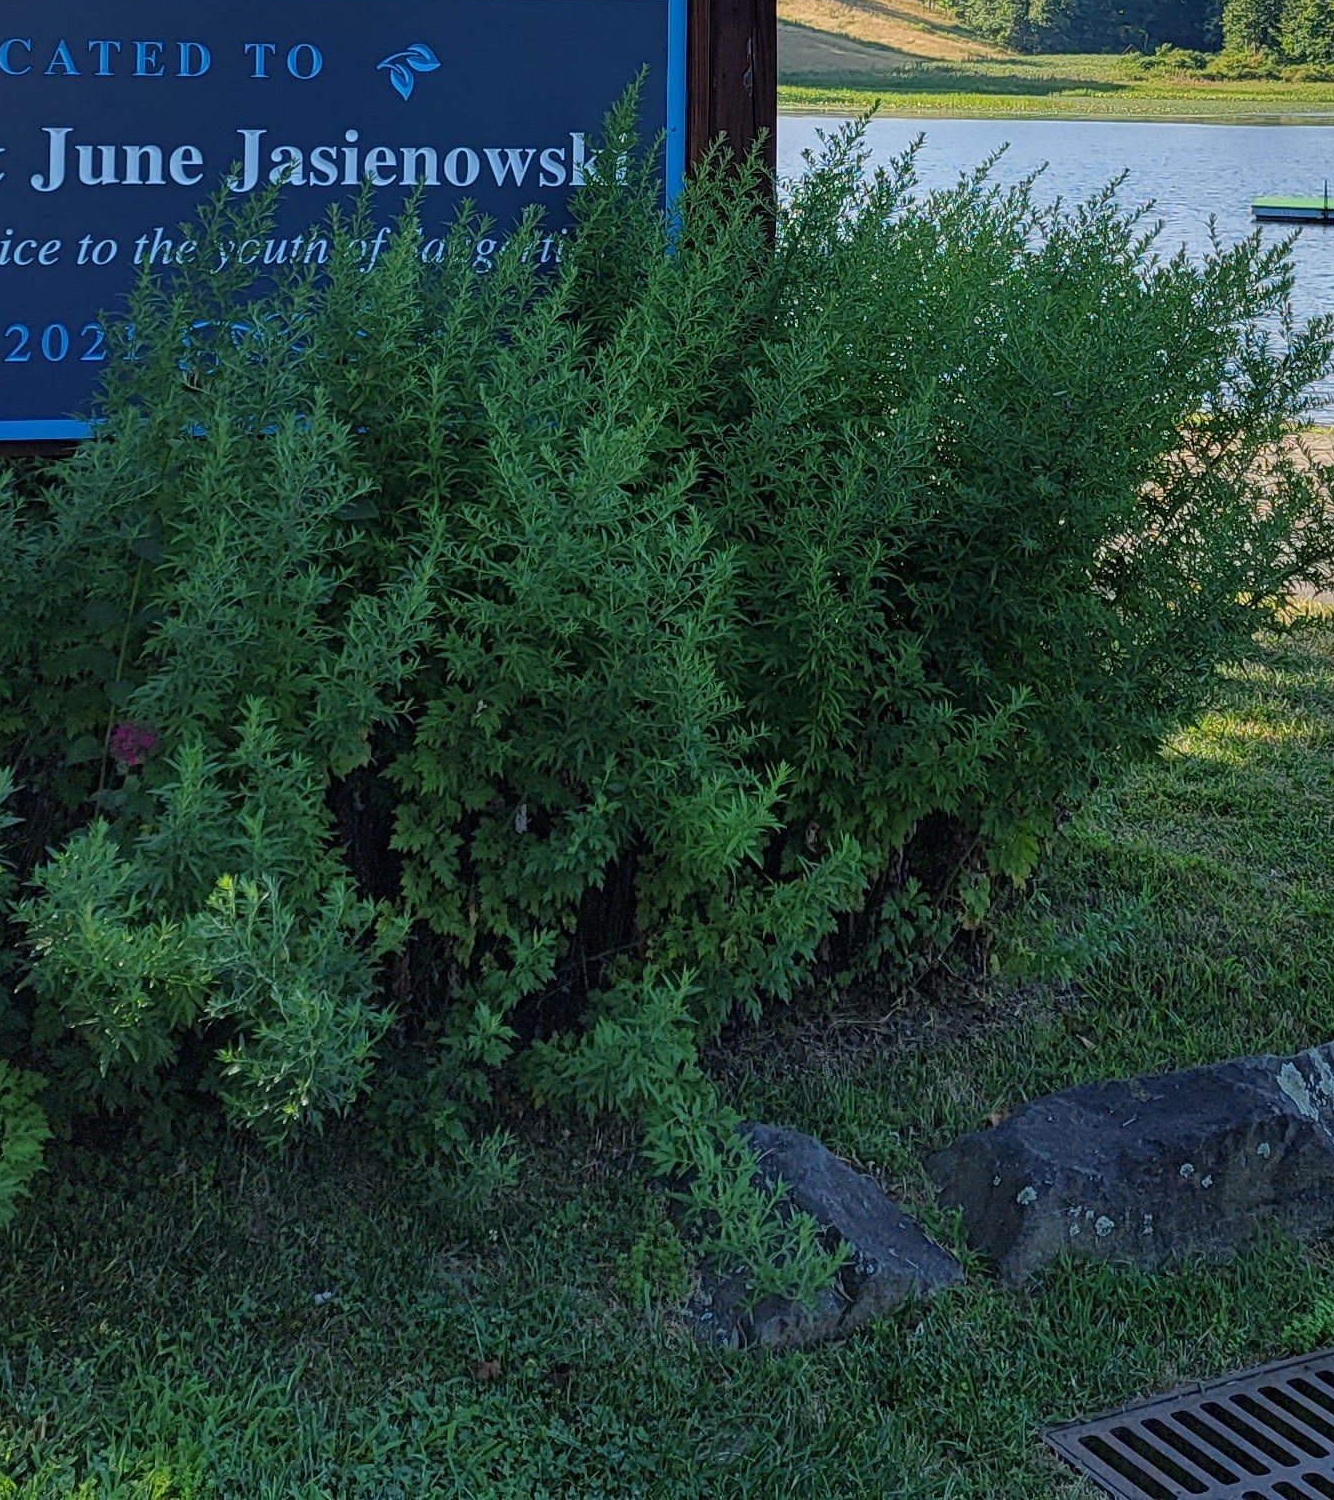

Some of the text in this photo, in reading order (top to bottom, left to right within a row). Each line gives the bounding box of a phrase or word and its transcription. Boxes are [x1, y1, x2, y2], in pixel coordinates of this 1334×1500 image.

[245, 41, 324, 80] TO
[30, 127, 204, 193] June
[76, 232, 119, 266] to
[132, 226, 198, 266] the
